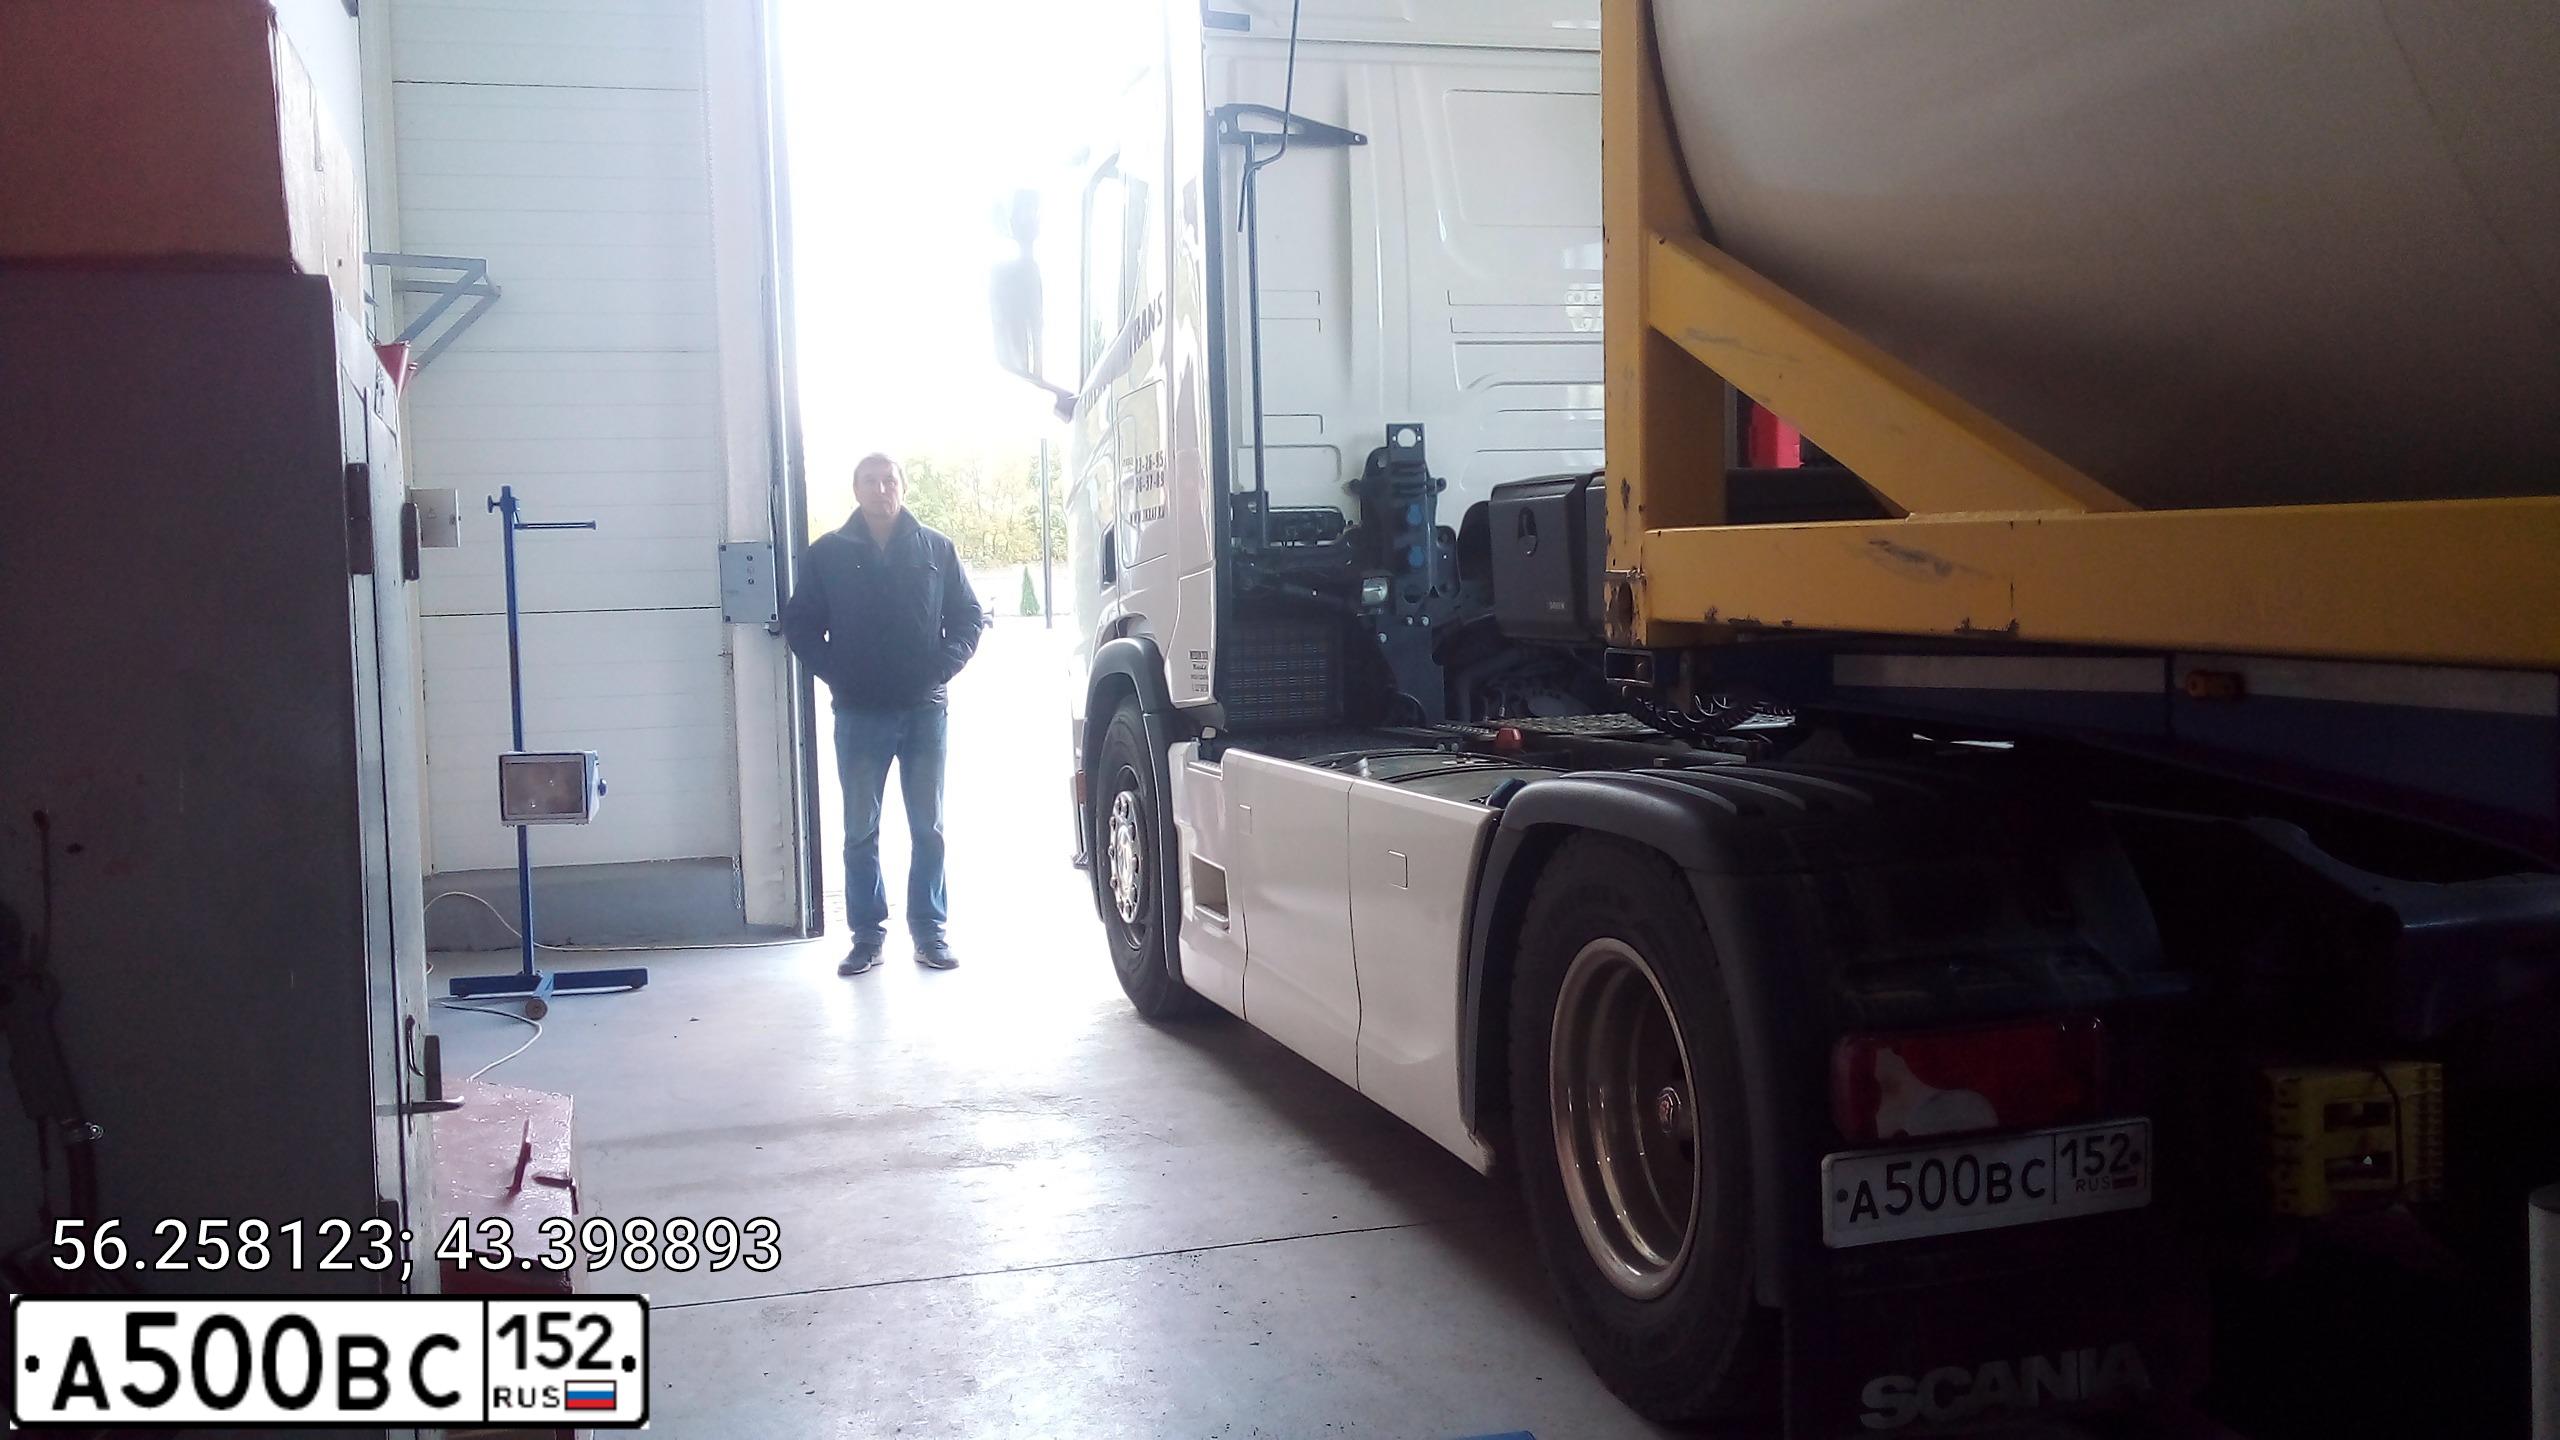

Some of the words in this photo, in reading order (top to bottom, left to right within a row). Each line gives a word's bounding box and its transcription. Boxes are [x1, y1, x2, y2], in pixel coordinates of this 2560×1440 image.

[1849, 1154, 2046, 1223] A500BC
[2059, 1133, 2132, 1178] 152
[2075, 1179, 2112, 1193] RUS
[1860, 1342, 2153, 1430] SCANIA
